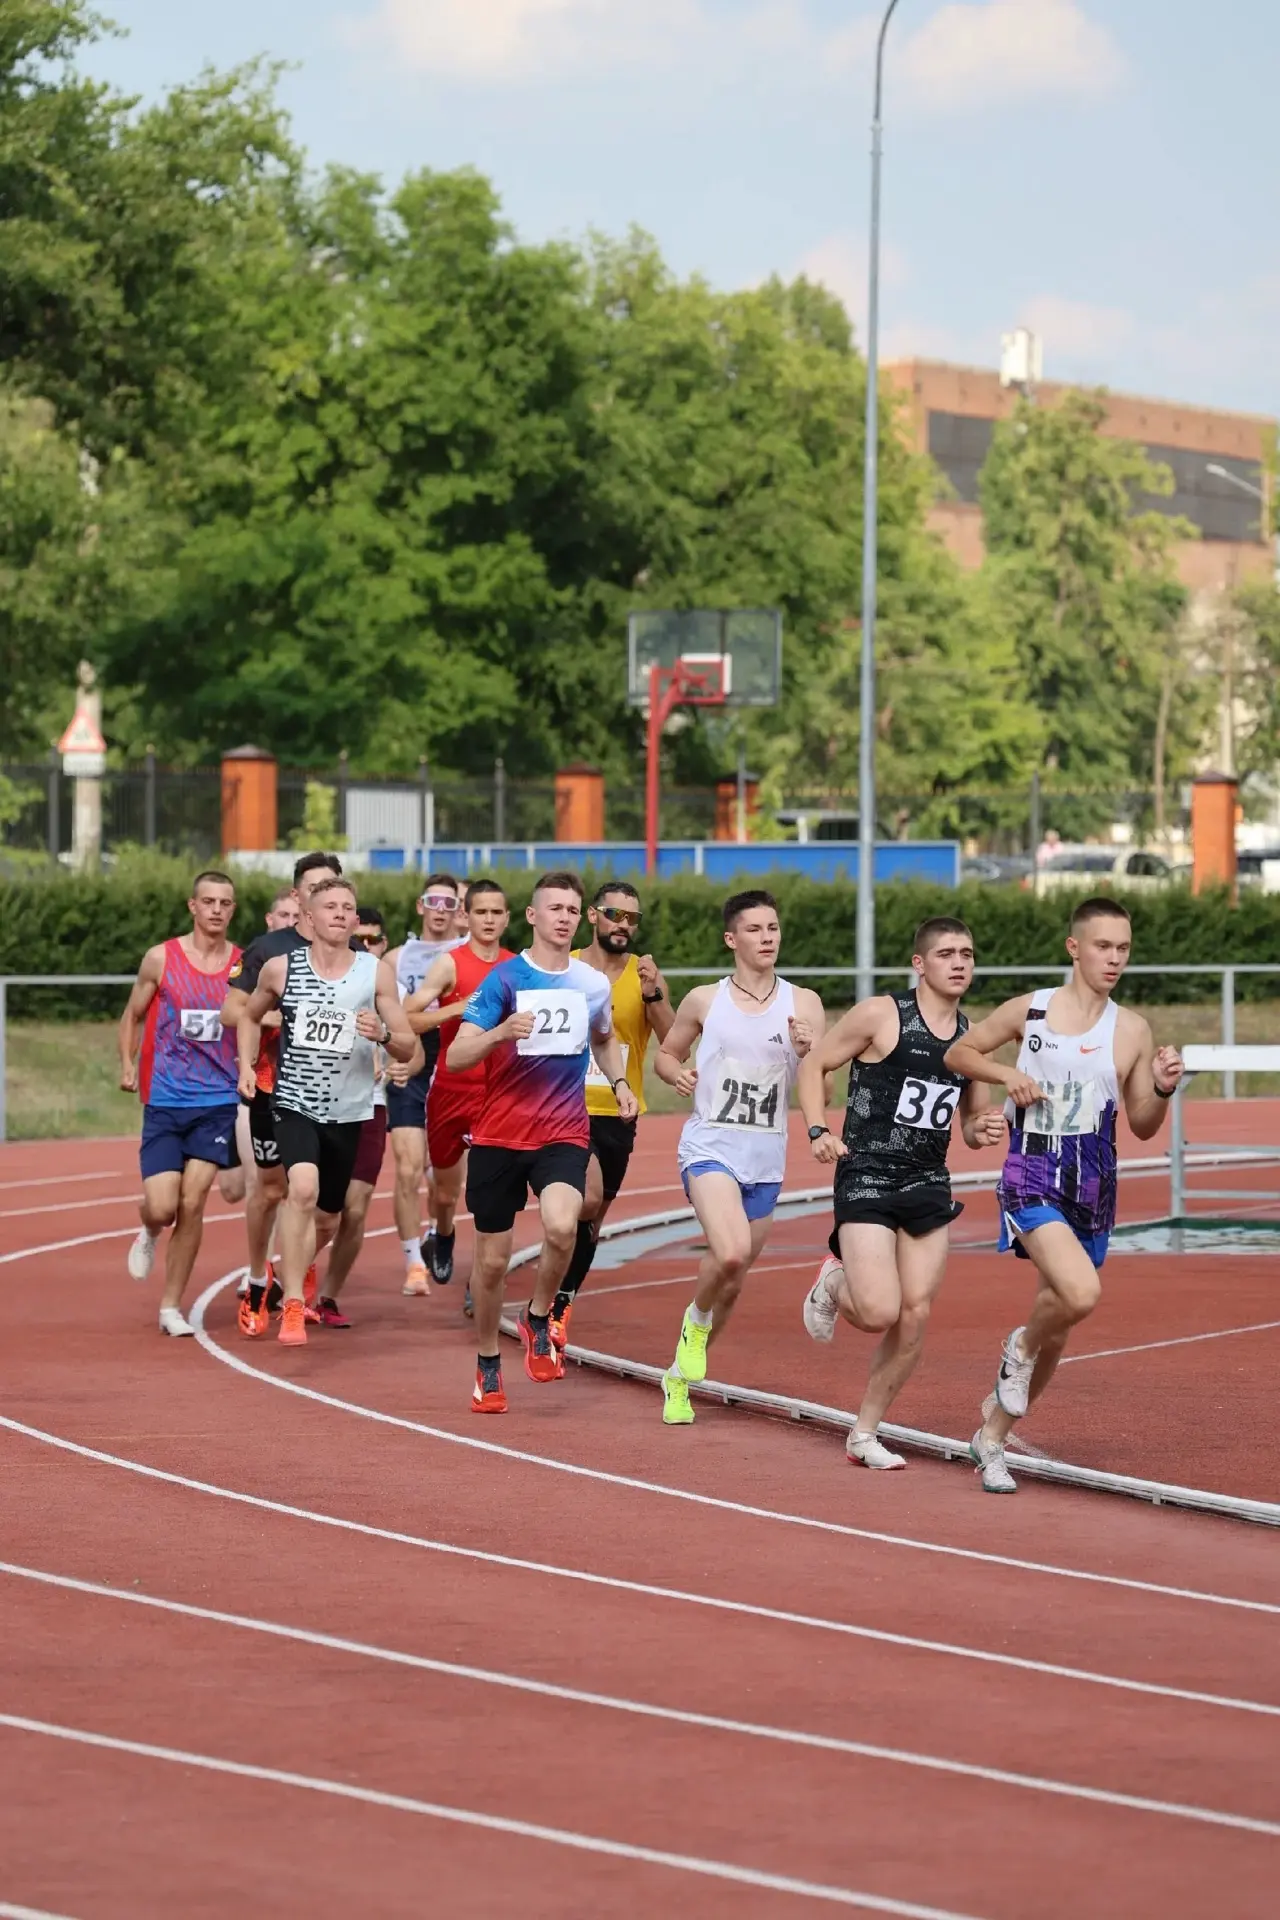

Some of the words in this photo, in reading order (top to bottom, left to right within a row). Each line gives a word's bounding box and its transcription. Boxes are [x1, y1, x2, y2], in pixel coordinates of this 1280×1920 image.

[184, 1014, 221, 1039] 51
[319, 1010, 347, 1022] asics
[537, 1008, 571, 1034] 22
[304, 1020, 343, 1045] 207
[716, 1078, 778, 1128] 254
[895, 1080, 956, 1129] 36
[252, 1136, 280, 1161] 52
